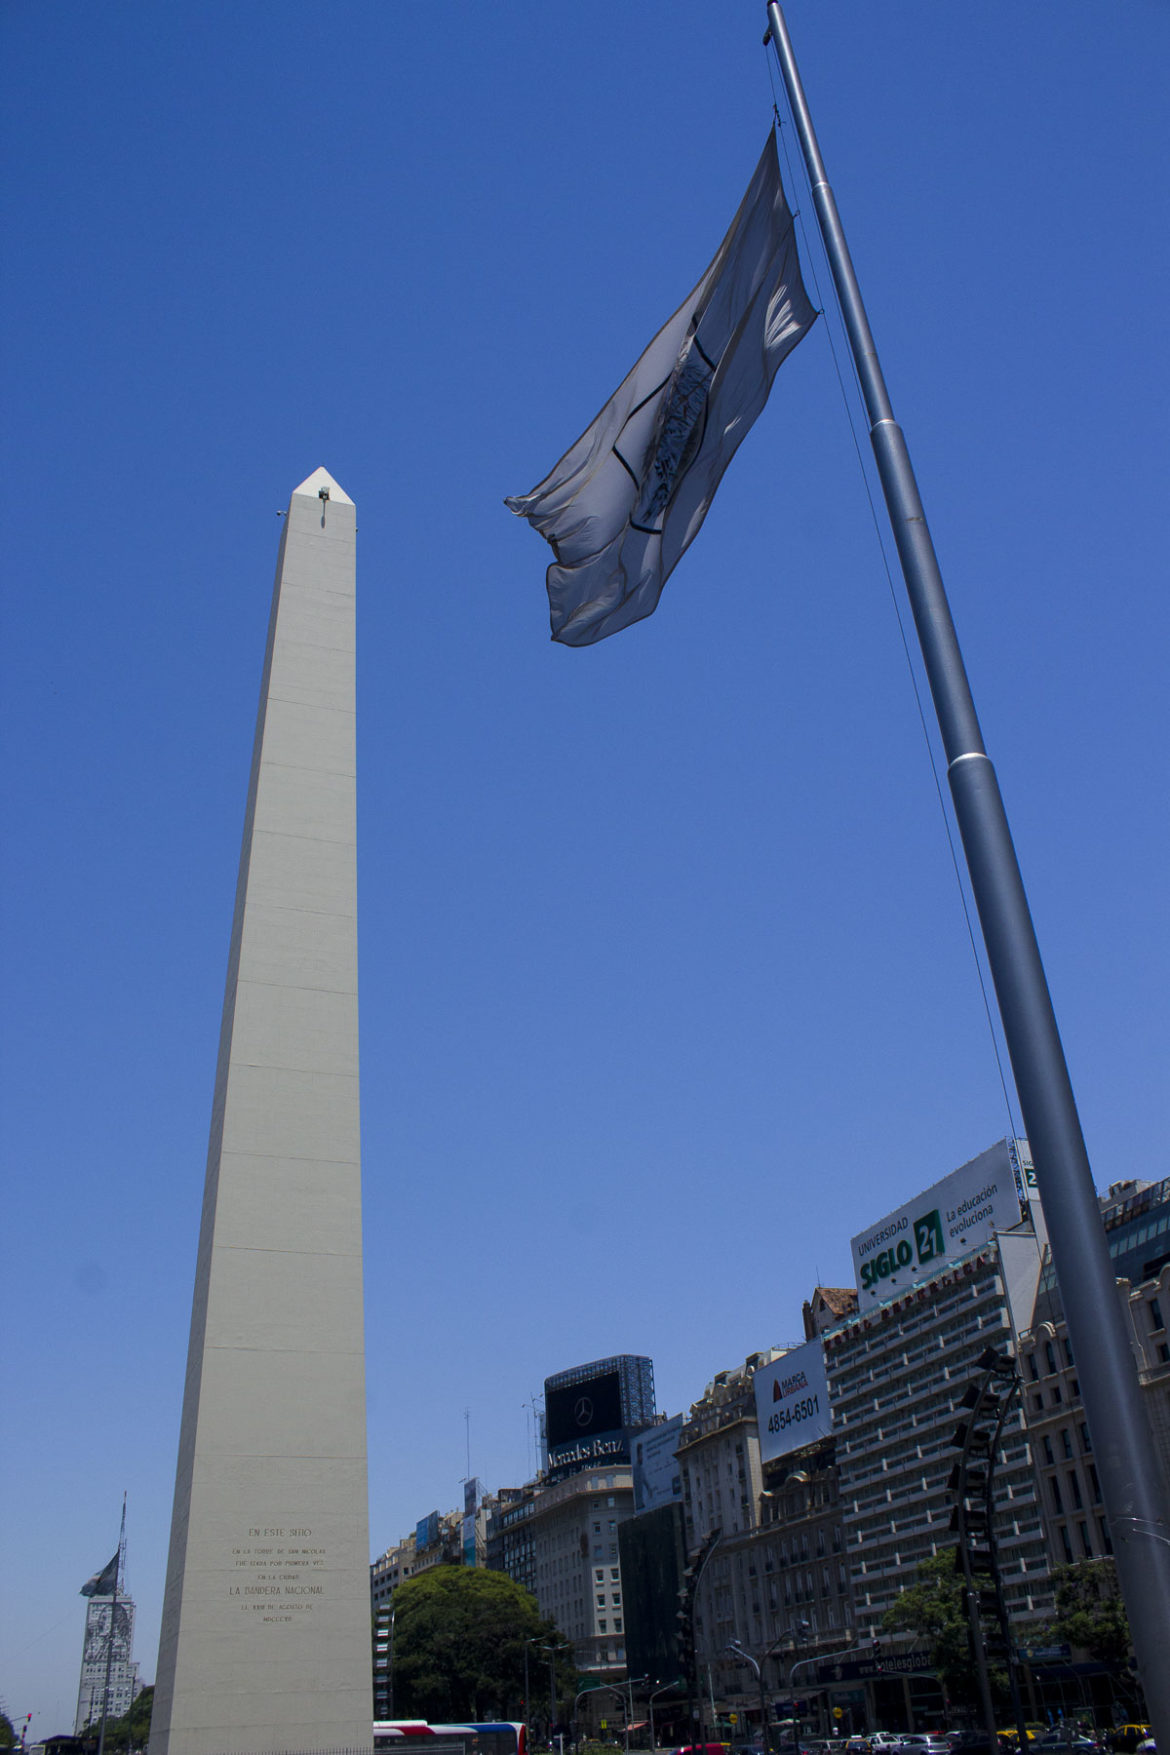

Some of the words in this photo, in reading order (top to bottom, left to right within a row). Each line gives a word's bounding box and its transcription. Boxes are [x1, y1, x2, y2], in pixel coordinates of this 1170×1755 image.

[945, 1211, 957, 1222] La
[957, 1184, 998, 1213] educación
[949, 1204, 994, 1237] evoluciona
[857, 1216, 909, 1257] UNIVERSIDAD
[859, 1239, 913, 1290] SIGLO
[918, 1224, 938, 1257] 21
[781, 1370, 807, 1391] MARCA
[767, 1393, 820, 1435] 4854-6501
[248, 1528, 260, 1537] EN
[264, 1528, 286, 1537] ESTE
[289, 1528, 312, 1537] SITIO
[229, 1586, 241, 1596] LA
[244, 1585, 281, 1596] BANDERA
[285, 1584, 326, 1595] NACIONAL
